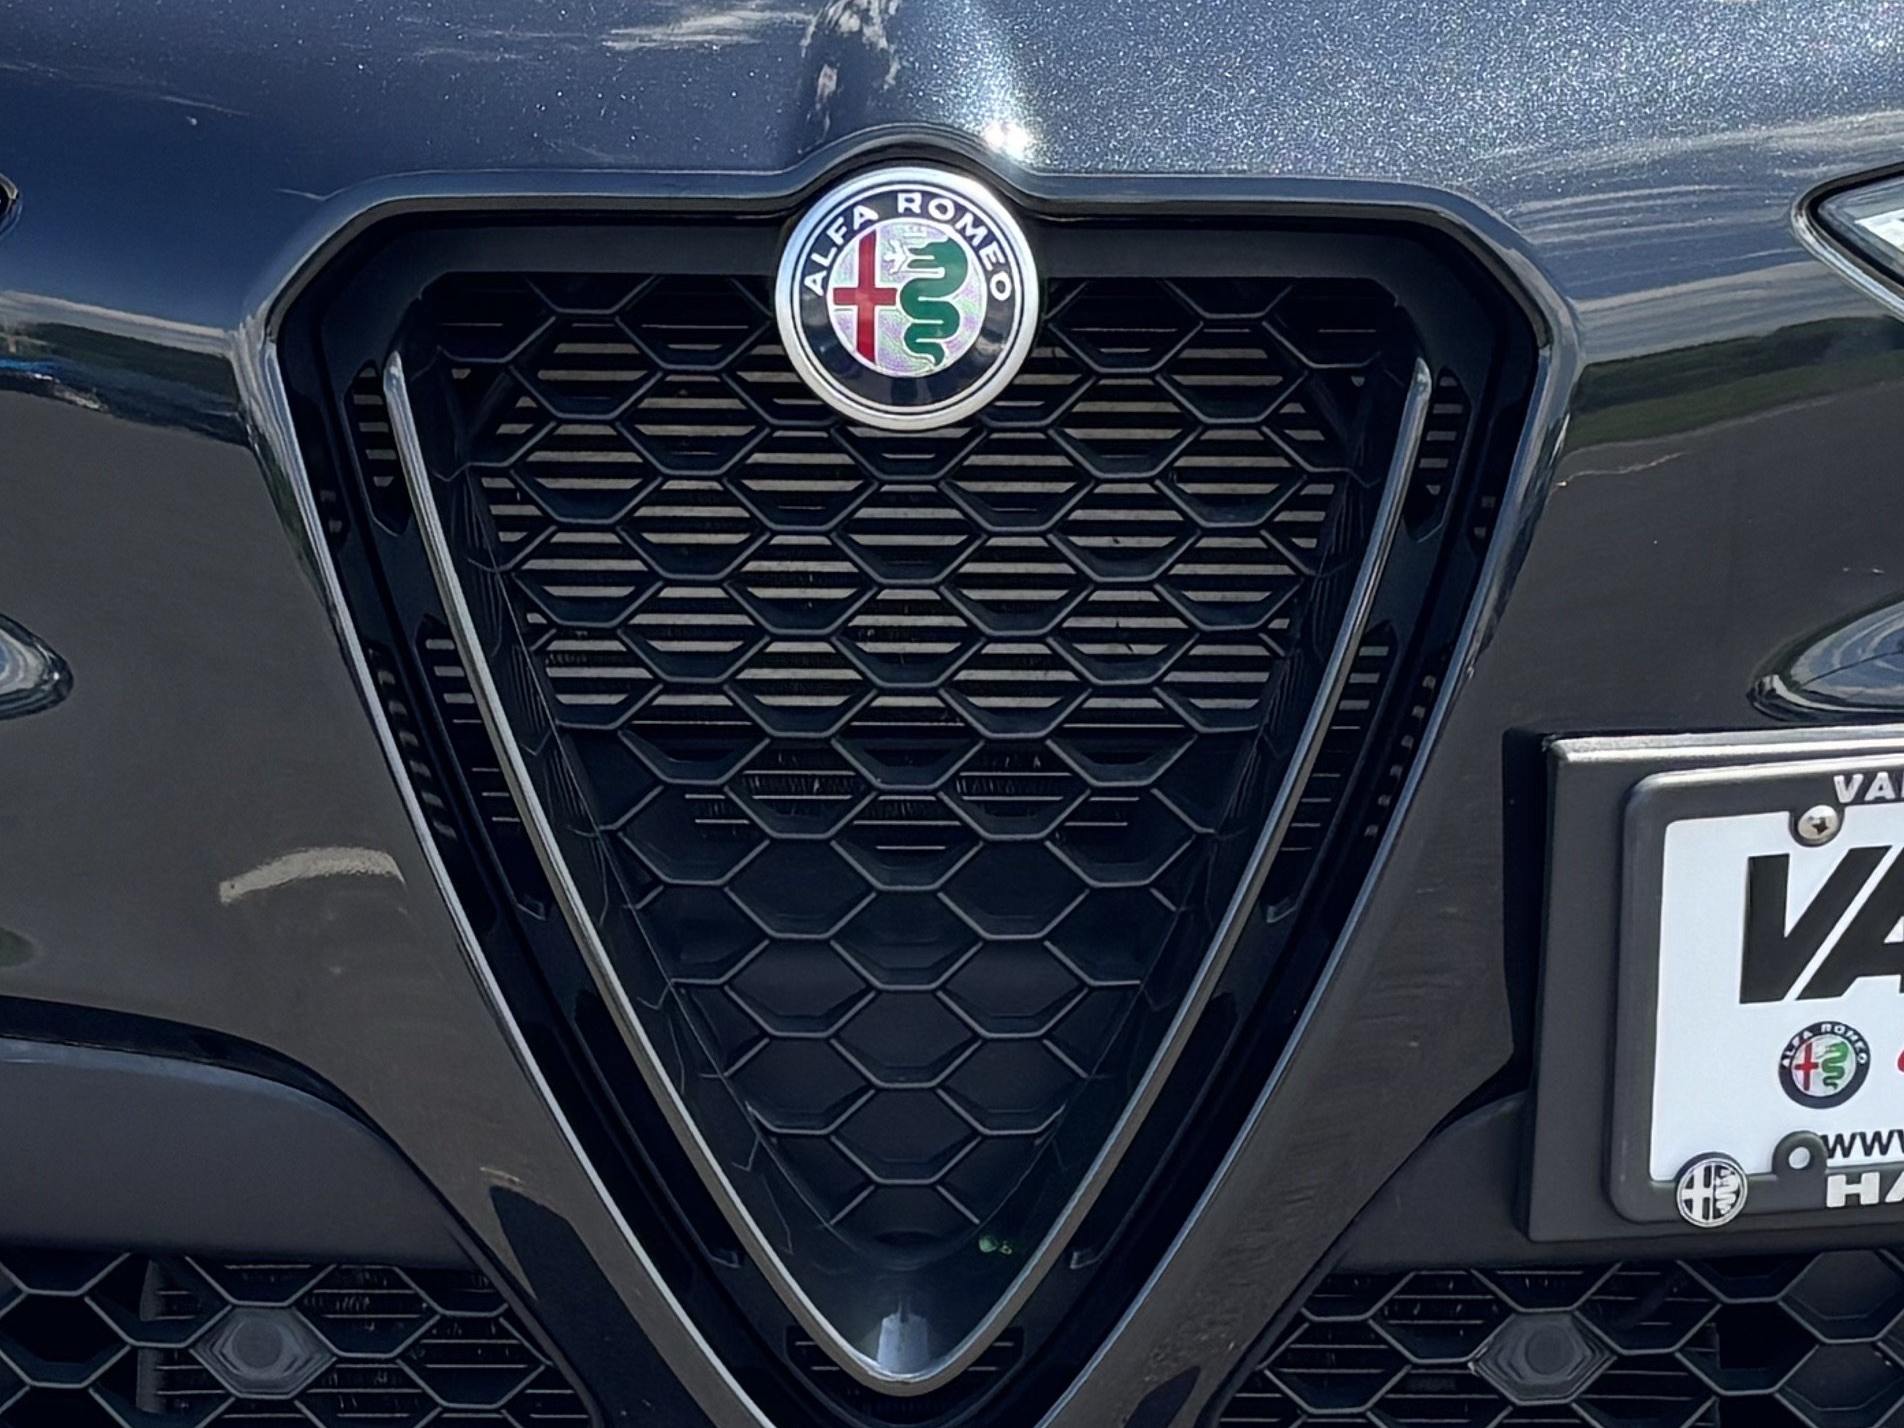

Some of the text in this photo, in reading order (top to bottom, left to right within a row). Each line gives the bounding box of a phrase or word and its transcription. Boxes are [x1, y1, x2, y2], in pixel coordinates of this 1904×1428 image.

[803, 191, 1013, 302] ALFA ROMEO
[1781, 1029, 1814, 1068] ALFA
